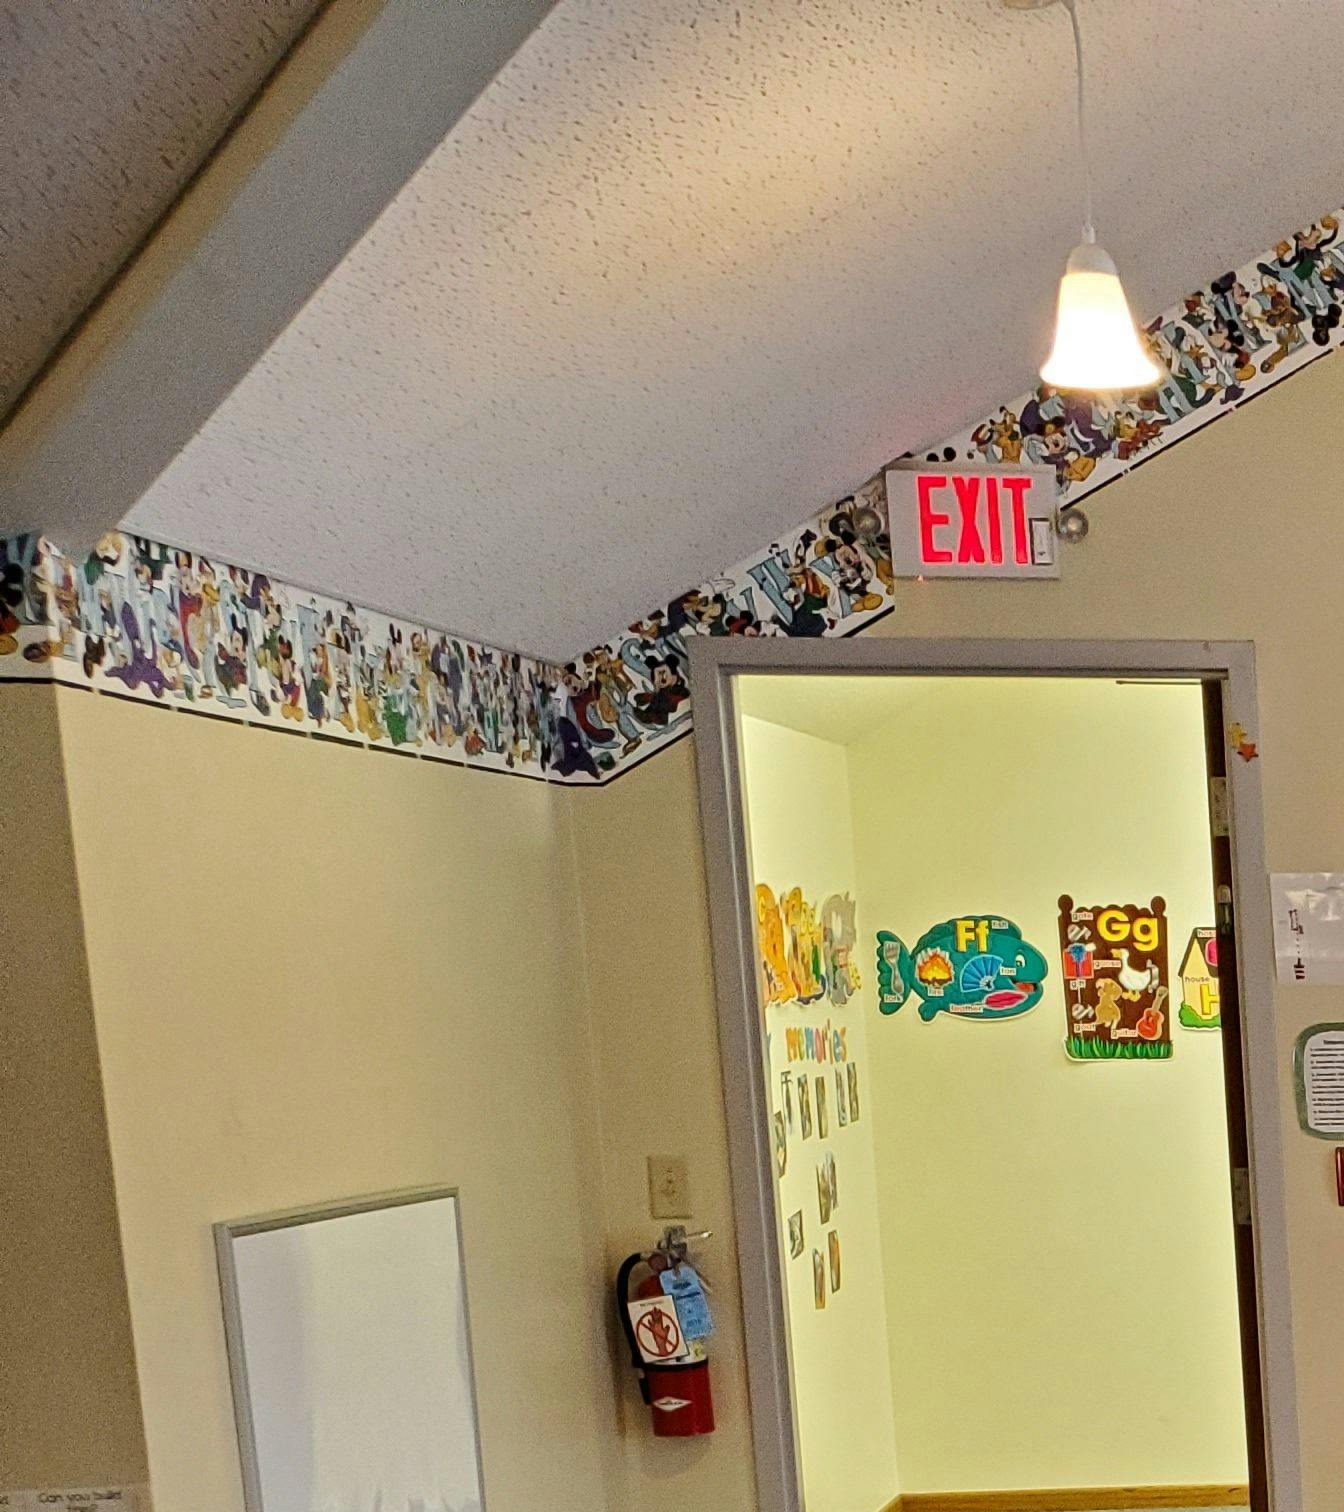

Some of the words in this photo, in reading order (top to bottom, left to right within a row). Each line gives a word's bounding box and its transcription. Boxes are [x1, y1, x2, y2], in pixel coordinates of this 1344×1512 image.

[917, 477, 1032, 565] EXIT
[955, 919, 990, 952] Ff
[1097, 910, 1159, 951] Gg
